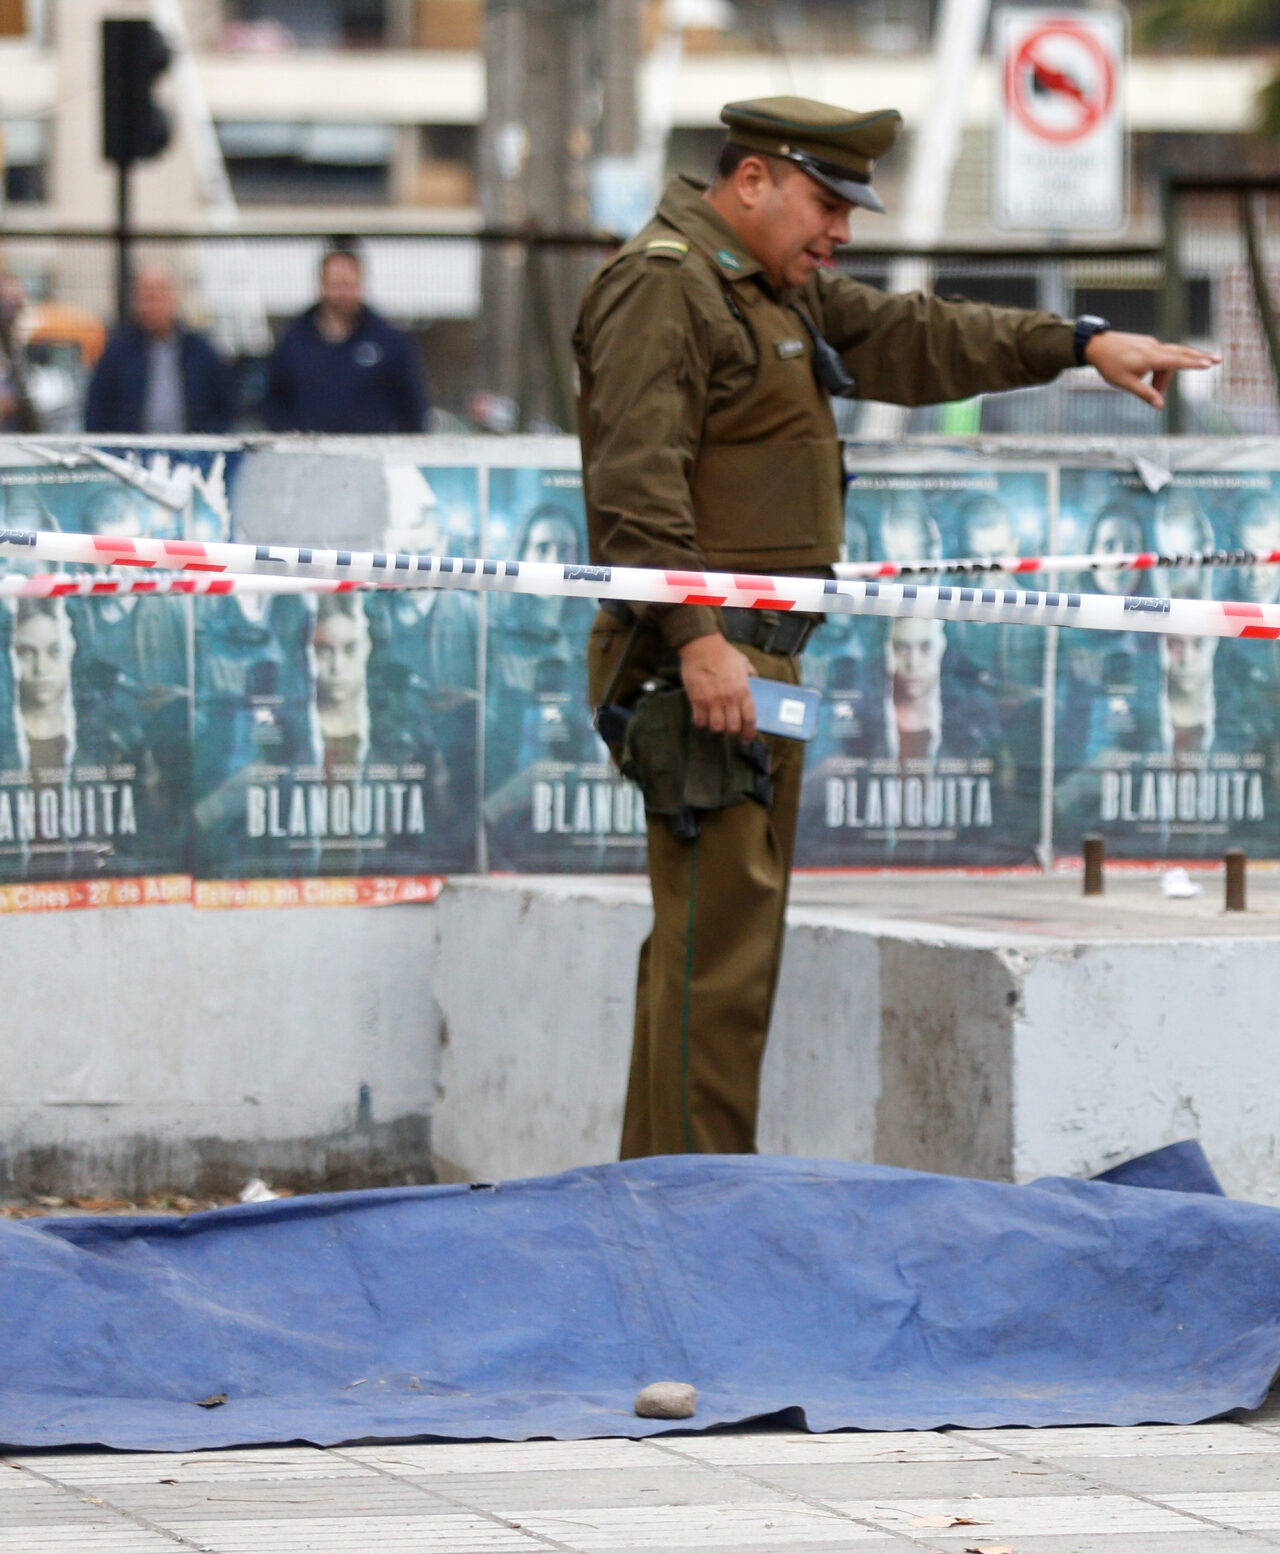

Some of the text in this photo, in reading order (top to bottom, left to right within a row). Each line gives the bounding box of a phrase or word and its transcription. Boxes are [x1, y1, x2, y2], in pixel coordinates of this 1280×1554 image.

[247, 784, 425, 837] BLANQUITA
[826, 777, 992, 828] BLANQUITA
[1100, 771, 1264, 821] BLANQUITA
[13, 886, 71, 910] Cines
[87, 881, 112, 904] 27
[117, 881, 141, 902] de
[145, 874, 192, 901] Abril
[374, 878, 399, 901] 27
